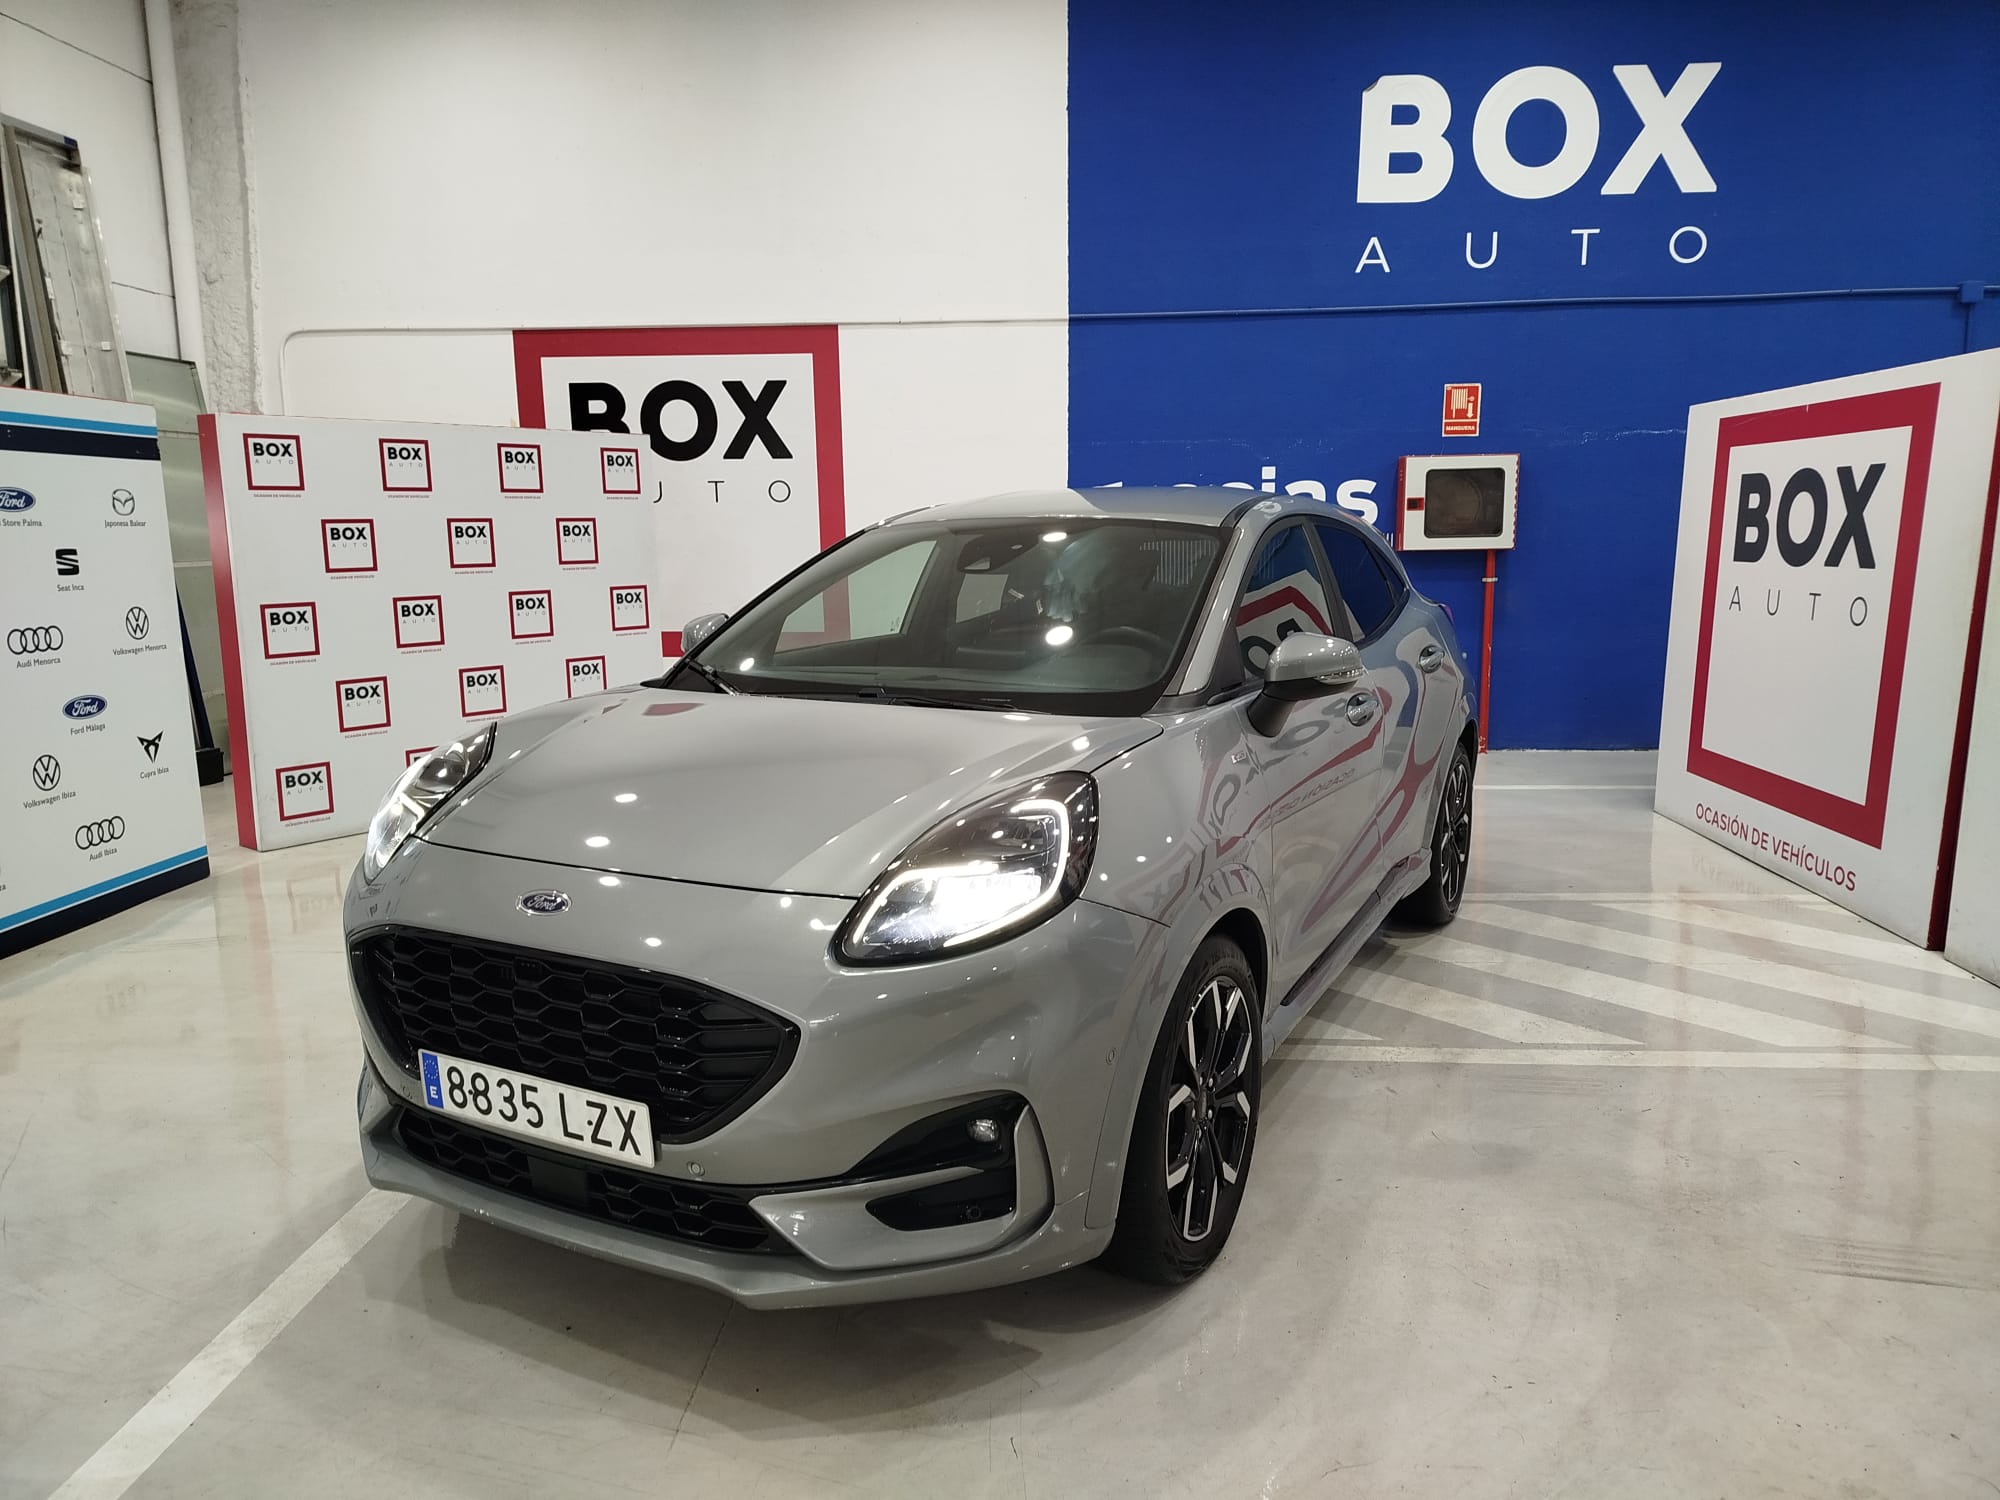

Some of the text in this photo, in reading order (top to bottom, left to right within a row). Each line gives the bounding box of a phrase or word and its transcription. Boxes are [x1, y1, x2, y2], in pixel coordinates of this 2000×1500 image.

[1357, 62, 1722, 203] BOX
[1355, 226, 1707, 273] AUTO
[569, 380, 793, 461] BOX
[253, 442, 293, 457] BOX
[387, 447, 422, 460] BOX
[505, 451, 535, 464] BOX
[607, 455, 633, 467] BOX
[1733, 463, 1886, 569] BOX
[330, 527, 367, 540] BOX
[455, 526, 487, 538] BOX
[563, 525, 591, 536] BOX
[516, 597, 545, 610] BOX
[616, 592, 642, 604] BOX
[401, 603, 435, 617] BOX
[1729, 586, 1867, 626] AUTO
[270, 610, 309, 626] BOX
[16, 657, 61, 668] Audi Menorca
[572, 663, 600, 676] BOX
[466, 673, 498, 688] BOX
[344, 685, 381, 701] BOX
[72, 699, 98, 716] Ford
[70, 727, 85, 735] Ford
[285, 770, 323, 789] BOX
[23, 791, 76, 808] Volkswagen Ibiza
[1695, 803, 1856, 891] OCASIÓN DE VEHÍCULOS
[89, 850, 103, 861] Audi
[430, 1066, 641, 1156] E 8835 LZX
